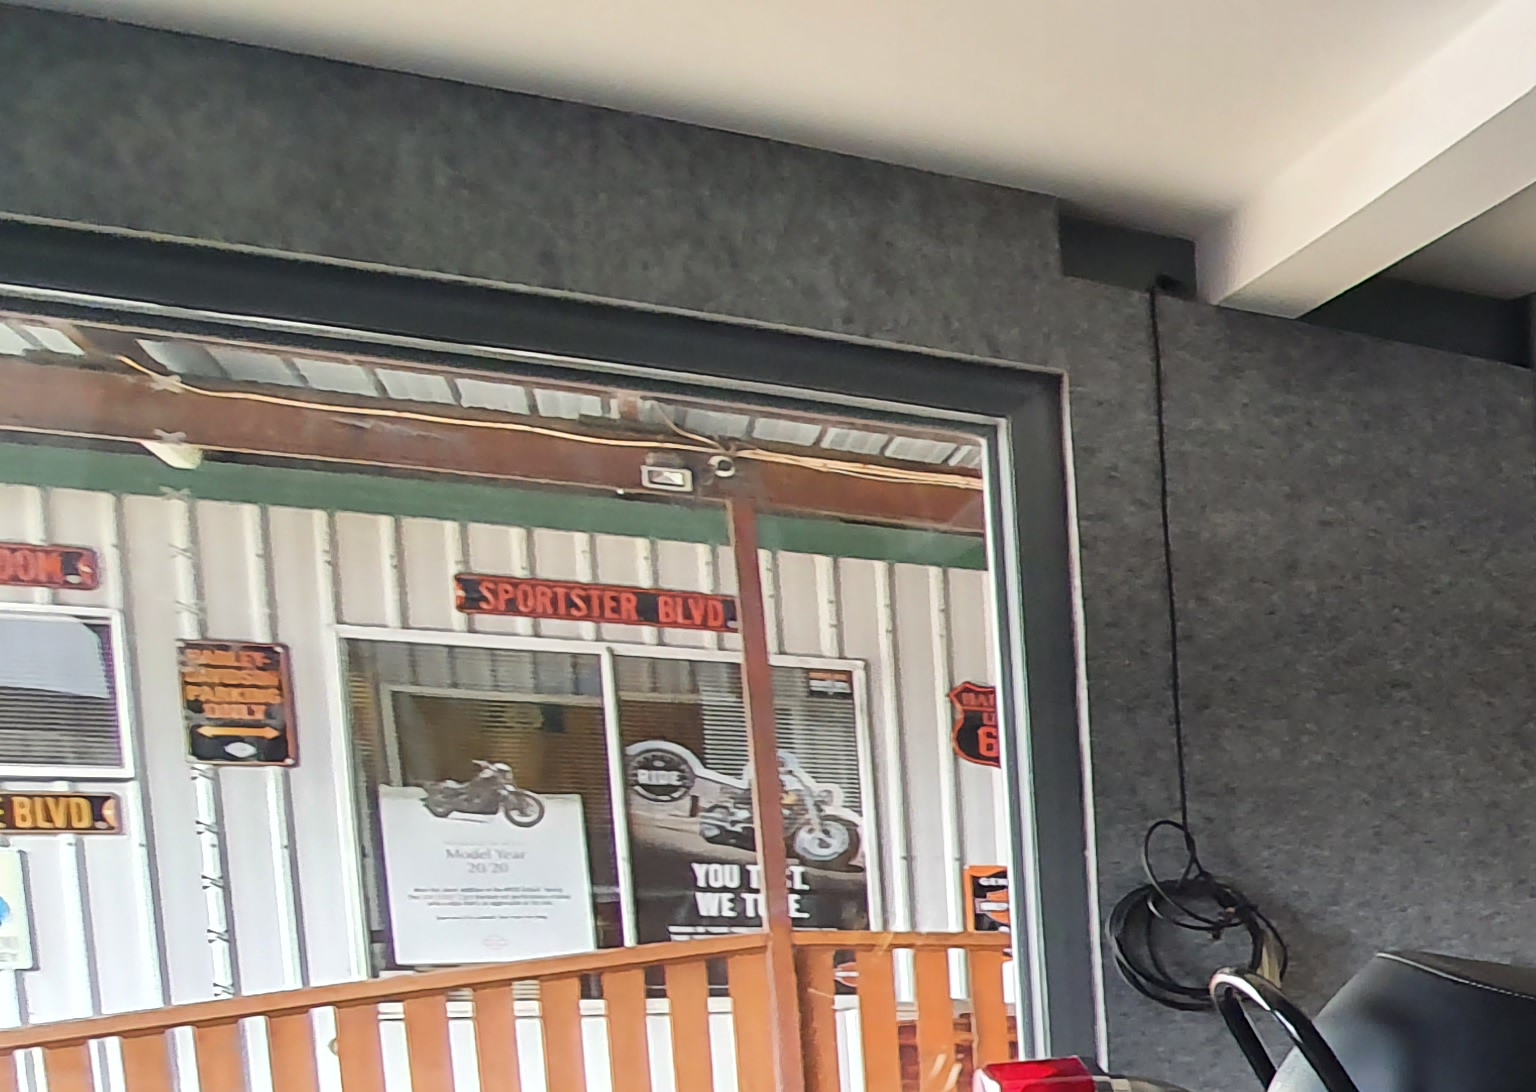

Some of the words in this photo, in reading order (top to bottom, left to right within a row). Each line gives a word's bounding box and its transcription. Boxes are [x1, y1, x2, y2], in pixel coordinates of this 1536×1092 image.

[478, 581, 639, 621] SPORTSTER
[658, 595, 725, 627] BLVD
[11, 796, 93, 829] BLVD
[445, 848, 492, 860] Model
[494, 848, 526, 860] Year
[691, 862, 741, 889] YOU
[694, 892, 738, 917] WE
